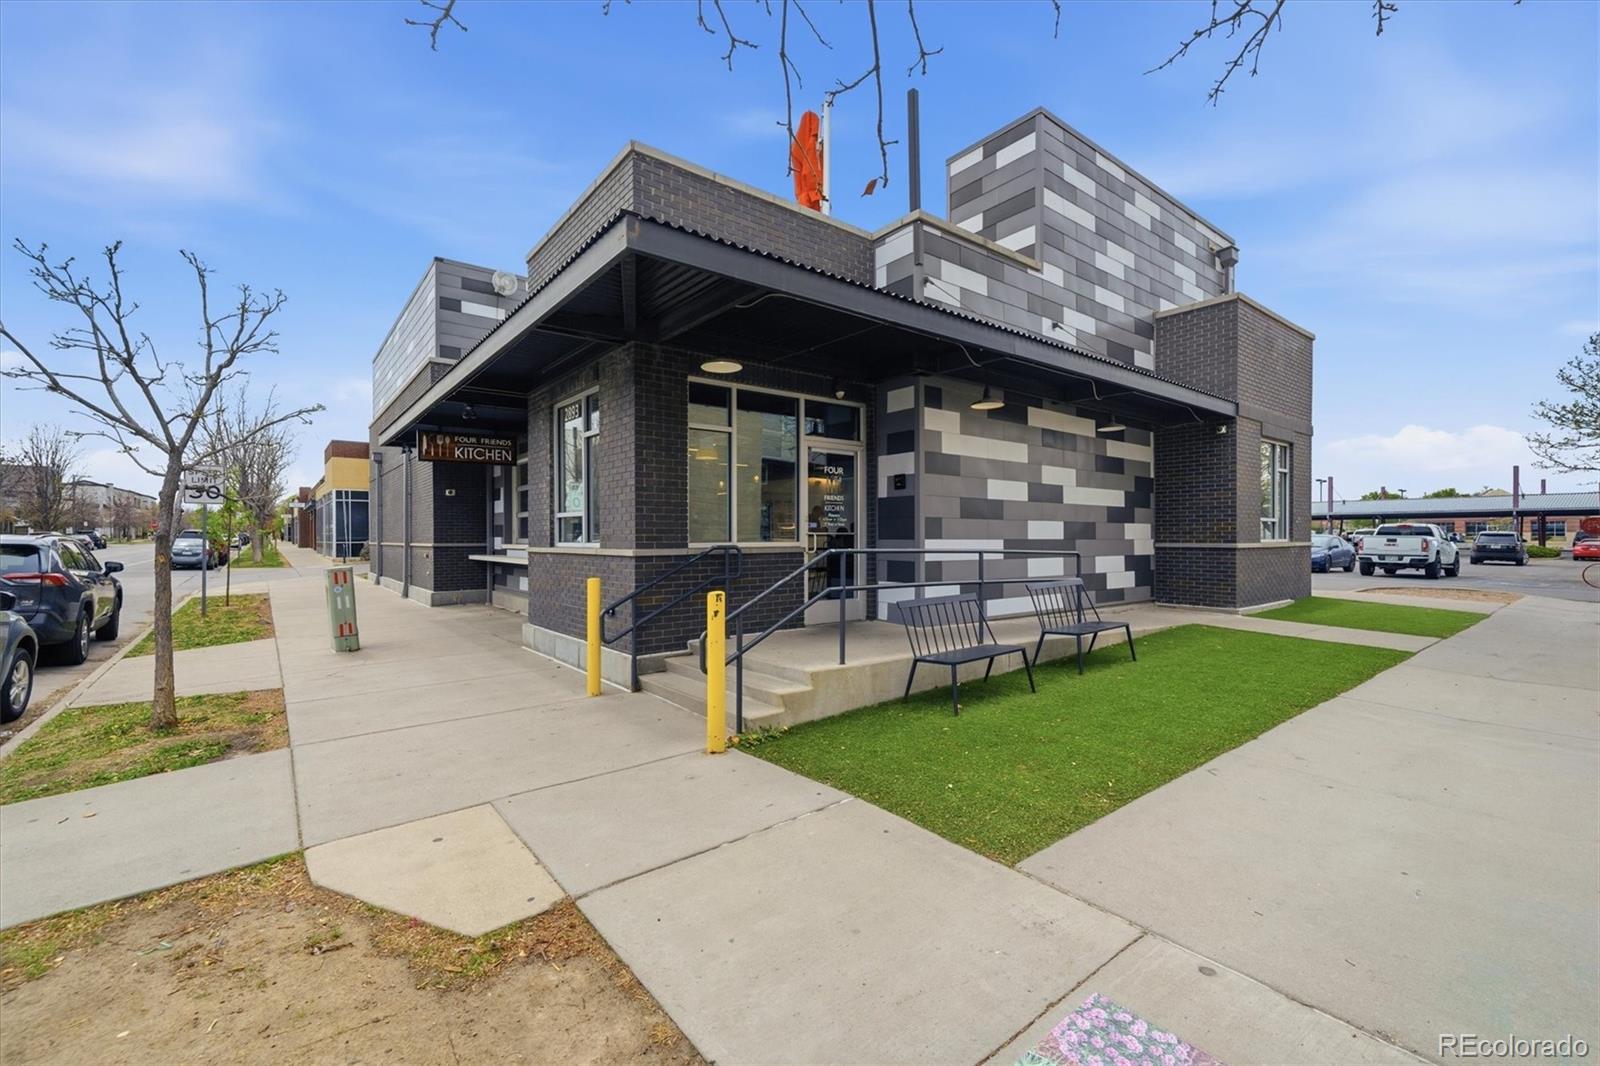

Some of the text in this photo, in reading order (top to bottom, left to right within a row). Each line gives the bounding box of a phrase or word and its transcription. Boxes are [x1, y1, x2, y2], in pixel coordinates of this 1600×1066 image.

[454, 435, 511, 446] FOUR FRIENDS
[454, 446, 512, 461] KITCHEN
[823, 465, 844, 474] FOUR
